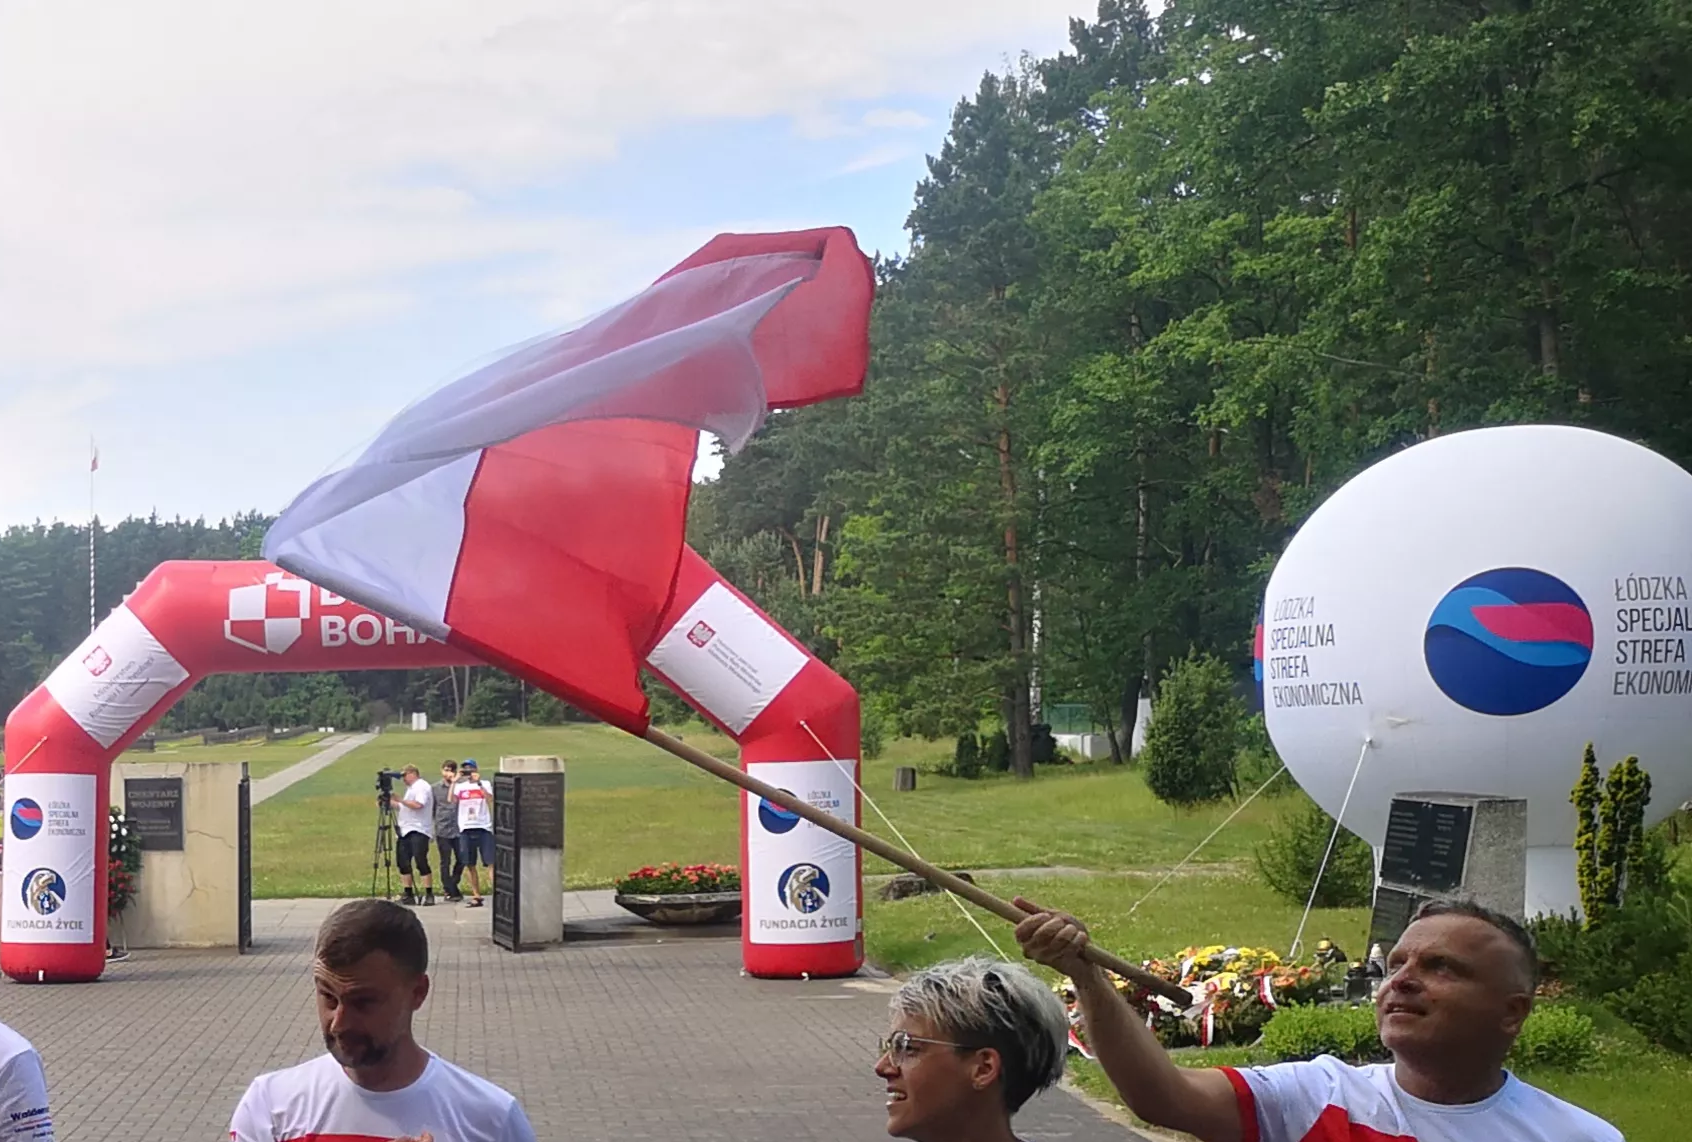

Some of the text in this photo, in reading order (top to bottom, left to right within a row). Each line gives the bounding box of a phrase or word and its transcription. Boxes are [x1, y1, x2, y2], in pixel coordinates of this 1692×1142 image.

[1614, 572, 1688, 601] ŁÓDZKA
[1271, 623, 1335, 651] SPECJALNA
[1615, 639, 1686, 665] STREFA
[1270, 655, 1309, 680] STREFA
[1272, 682, 1363, 708] EKONOMICZNA
[55, 917, 85, 930] ŻYCIE
[760, 915, 849, 930] FUNDACJA ŻYCIE
